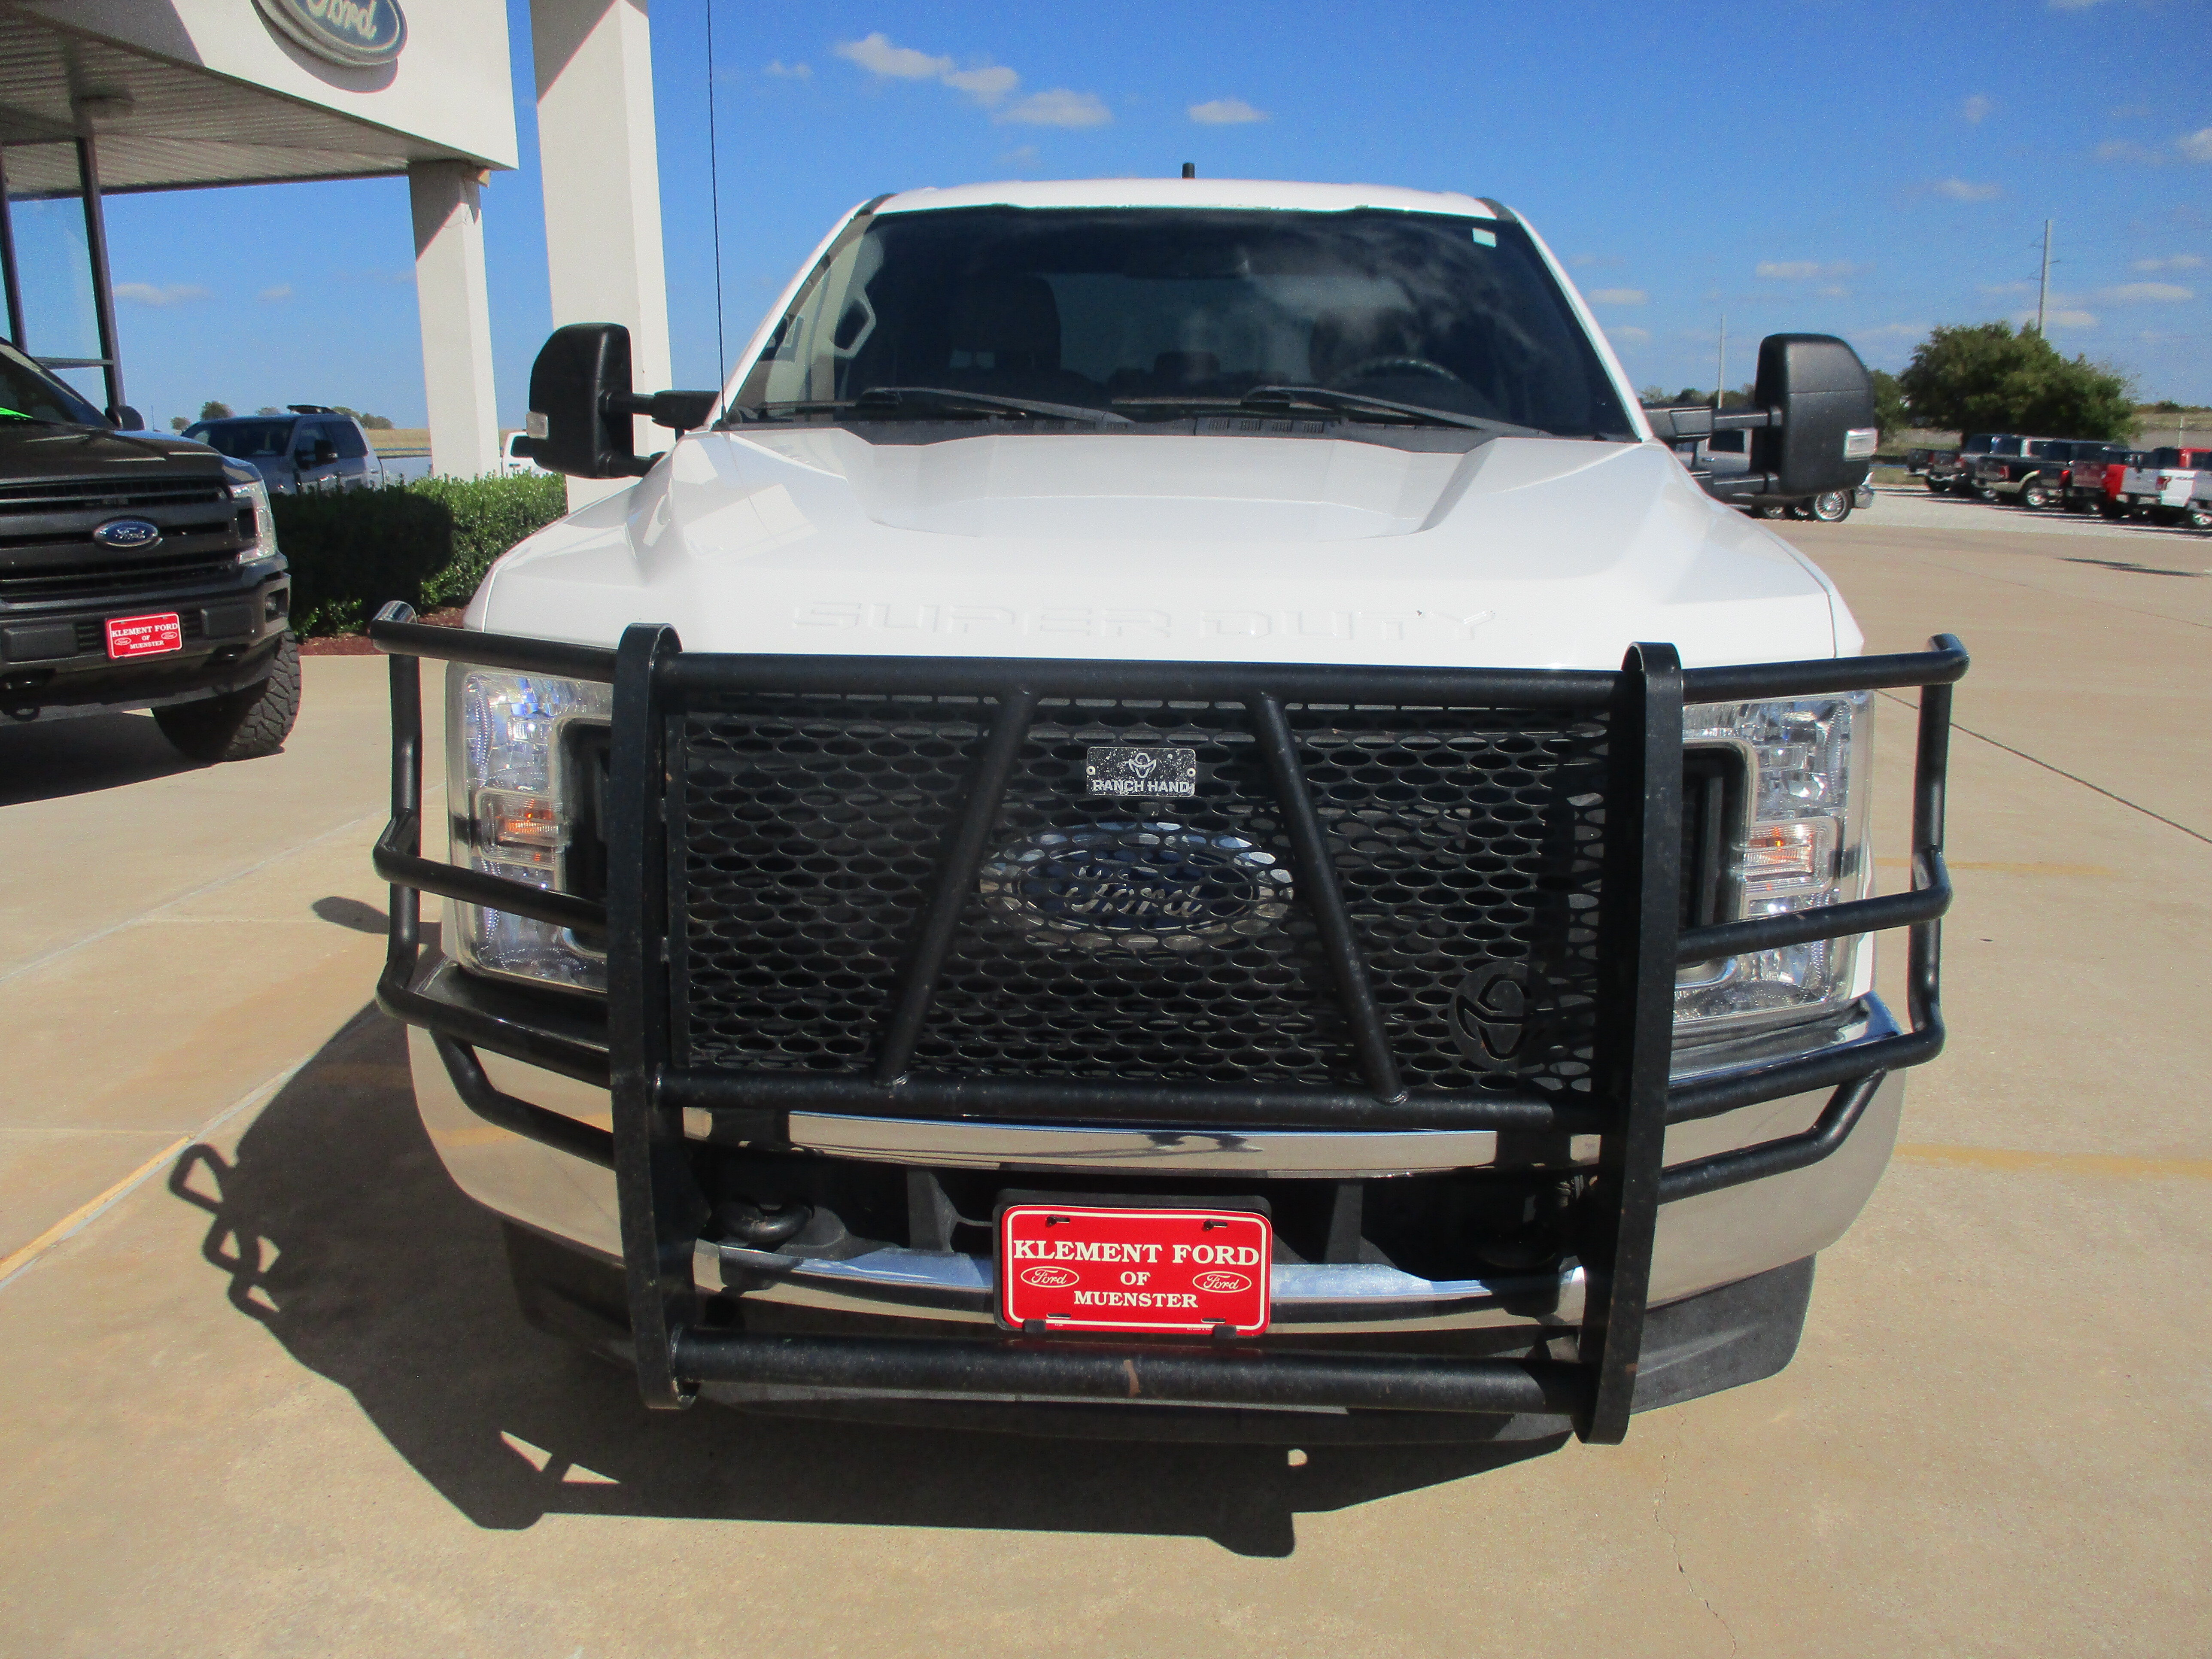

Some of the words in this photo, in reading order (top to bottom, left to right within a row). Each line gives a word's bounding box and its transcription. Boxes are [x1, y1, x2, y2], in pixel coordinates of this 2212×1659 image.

[792, 601, 1172, 638] SUPER
[1199, 610, 1496, 641] DUTY
[112, 626, 152, 637] KLEMENT
[155, 623, 178, 632] FORD
[130, 640, 165, 649] MUENSTER
[1093, 779, 1144, 791] RANCH
[1014, 1240, 1162, 1263] KLEMENT
[1173, 1245, 1259, 1265] FORD
[1031, 1269, 1067, 1285] Ford
[1120, 1271, 1151, 1286] OF
[1203, 1274, 1239, 1289] Ford
[1074, 1291, 1198, 1308] MUENSTER
